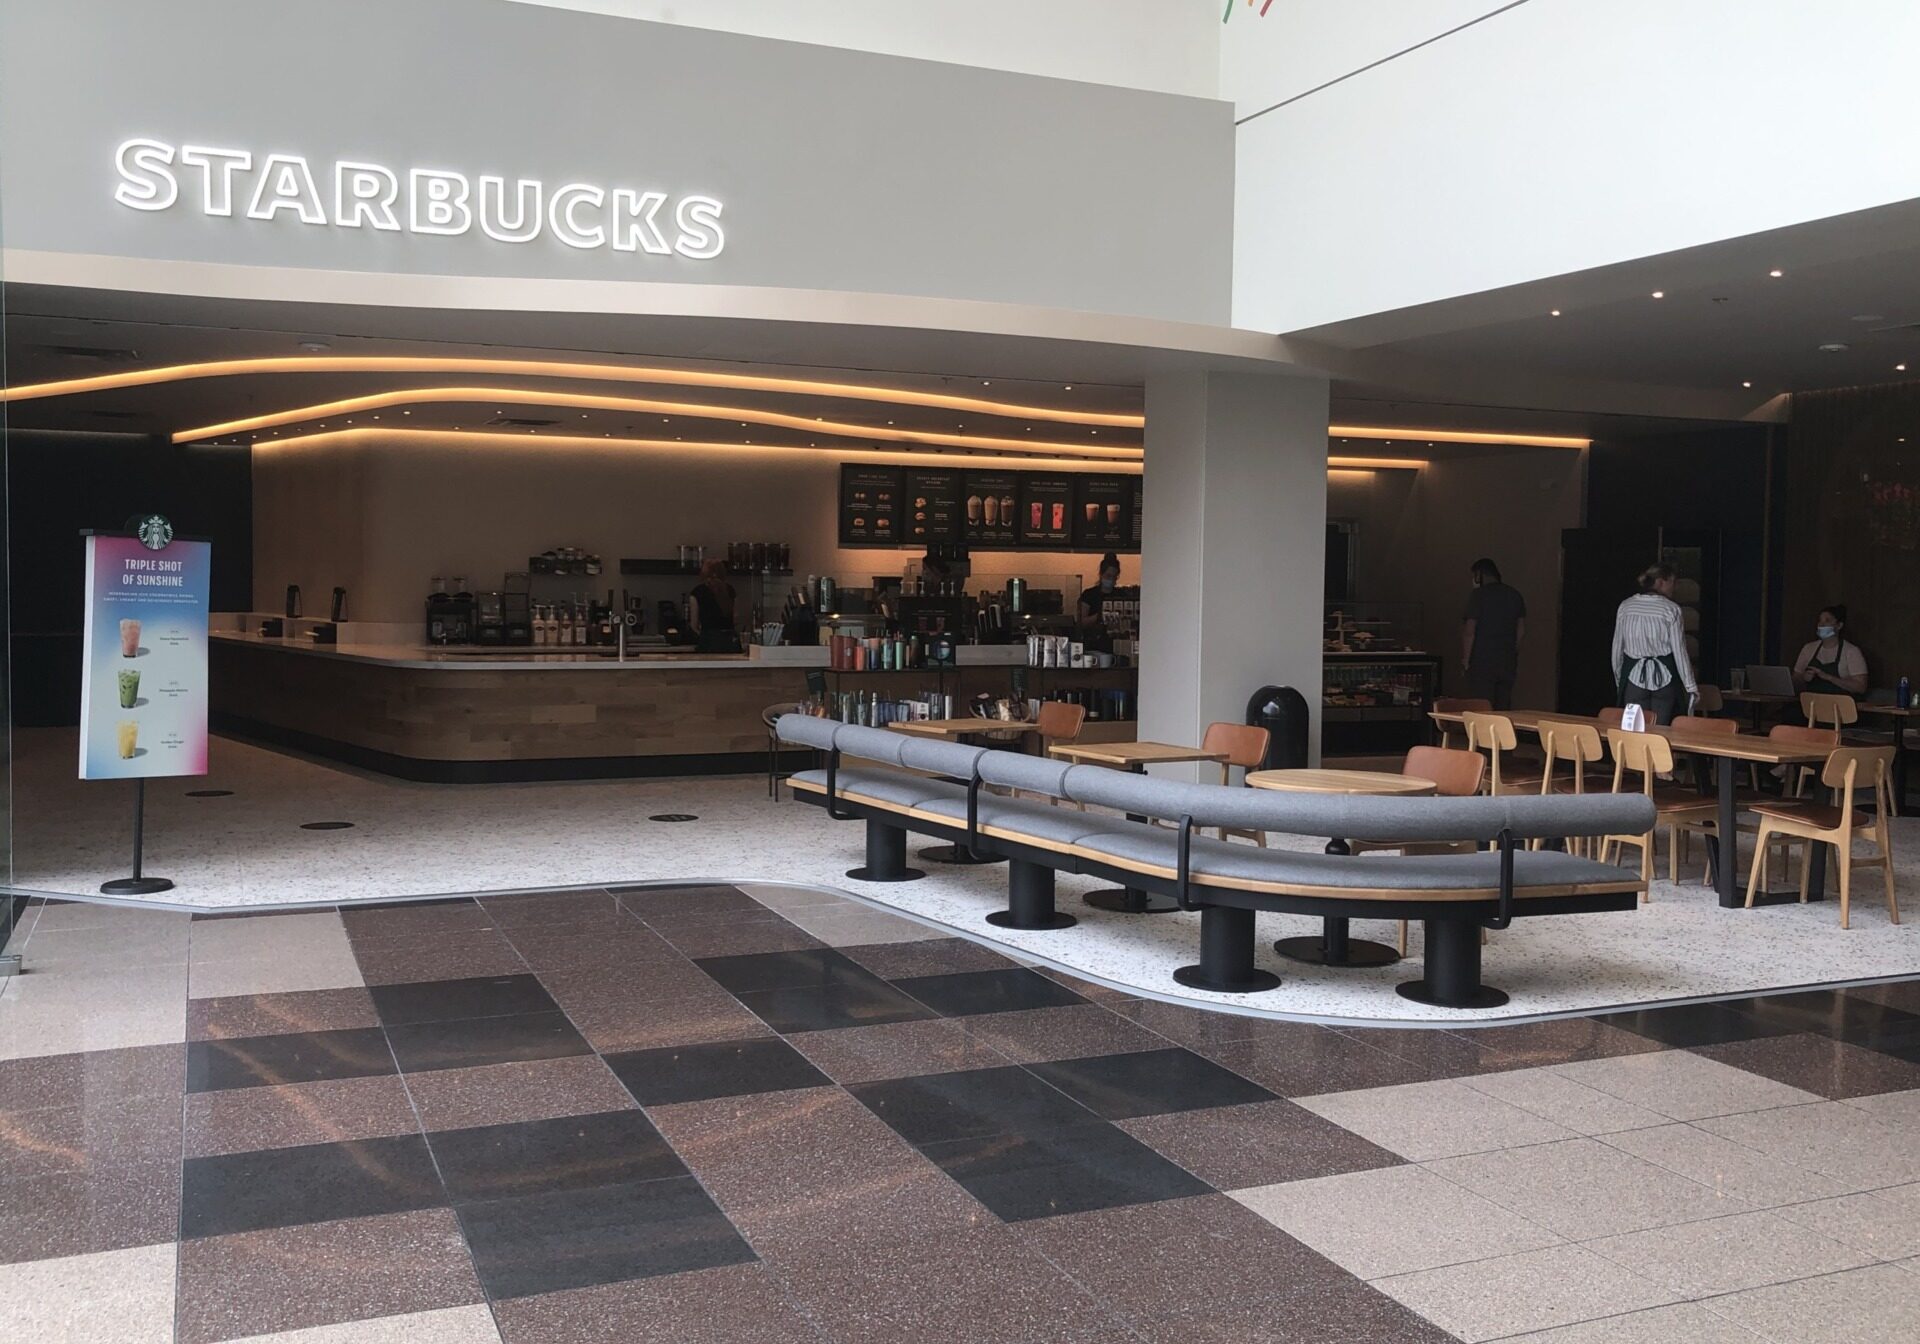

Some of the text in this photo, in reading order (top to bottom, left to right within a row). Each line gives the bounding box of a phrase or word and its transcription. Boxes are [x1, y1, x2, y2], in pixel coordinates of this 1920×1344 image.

[114, 138, 725, 259] STARBUCKS
[124, 559, 183, 572] TRIPLE SHOT
[122, 574, 184, 587] OF SUNSHINE
